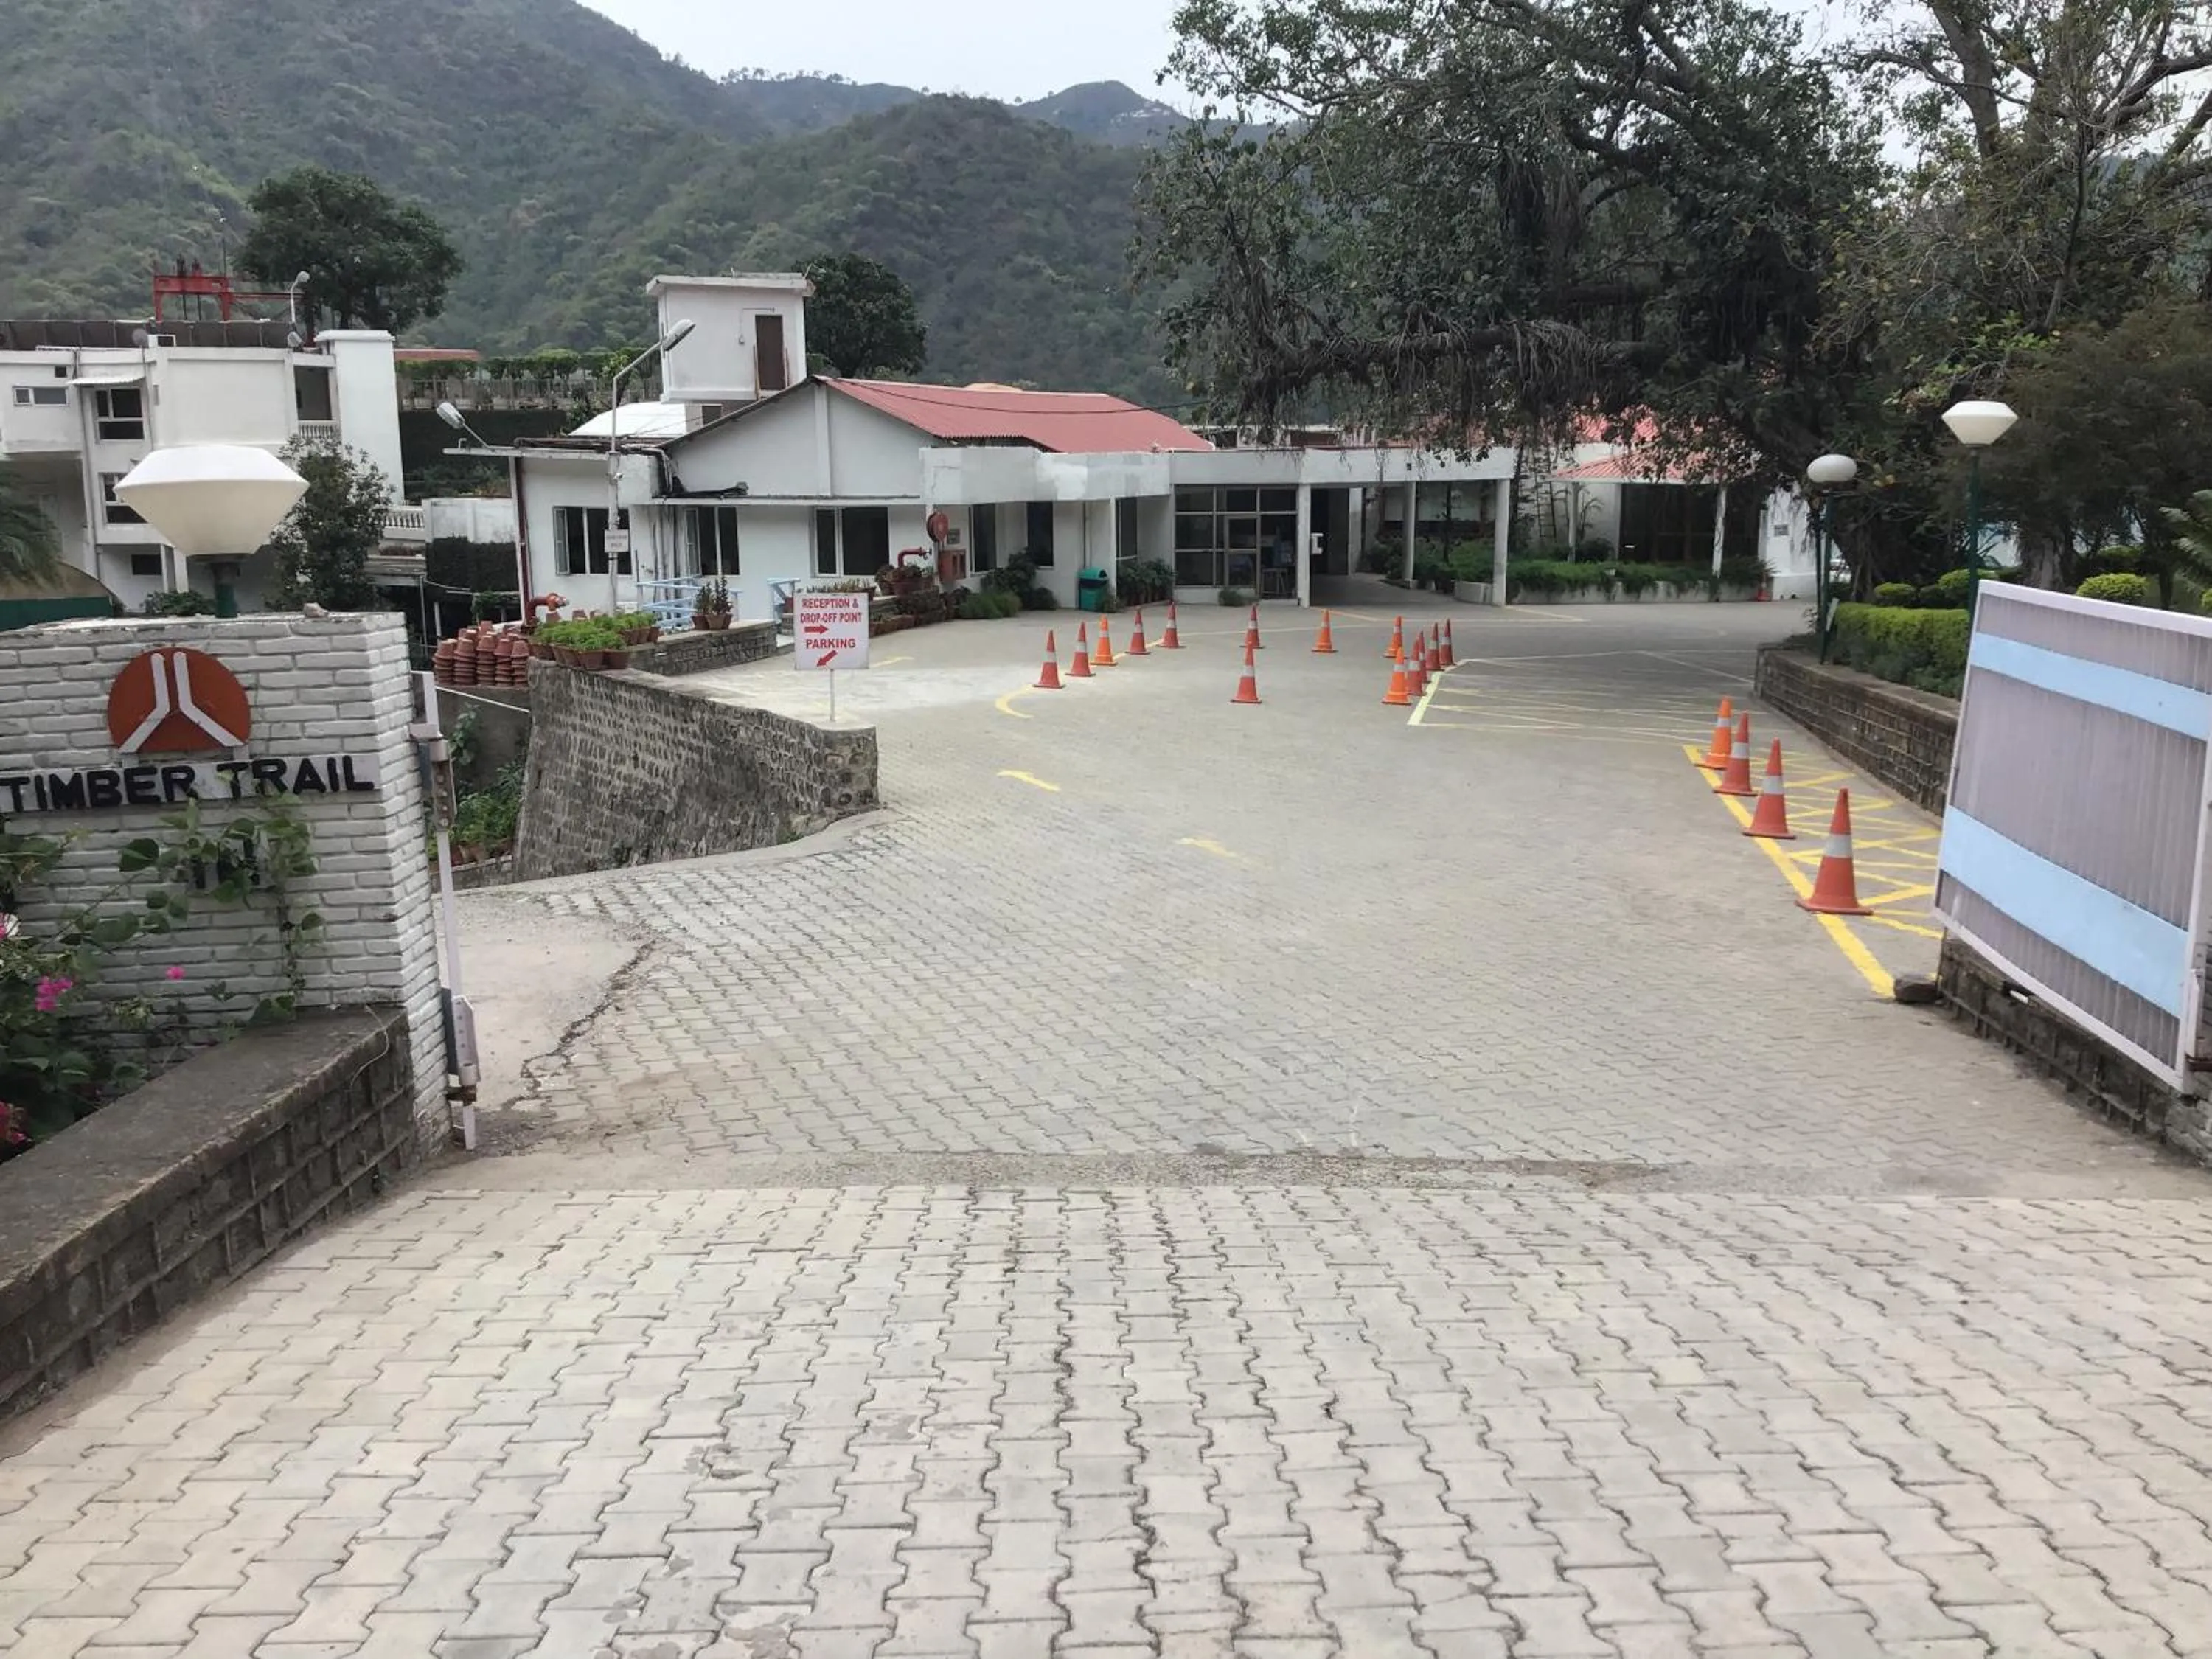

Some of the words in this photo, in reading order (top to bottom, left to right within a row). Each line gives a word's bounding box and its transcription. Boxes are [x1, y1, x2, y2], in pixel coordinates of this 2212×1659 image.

[801, 598, 850, 608] RECEPTION
[852, 598, 859, 608] &
[800, 613, 838, 623] DROP-OFF
[839, 612, 862, 623] POINT
[806, 638, 856, 649] PARKING
[0, 765, 198, 812] TIMBER
[216, 754, 375, 799] TRAIL
